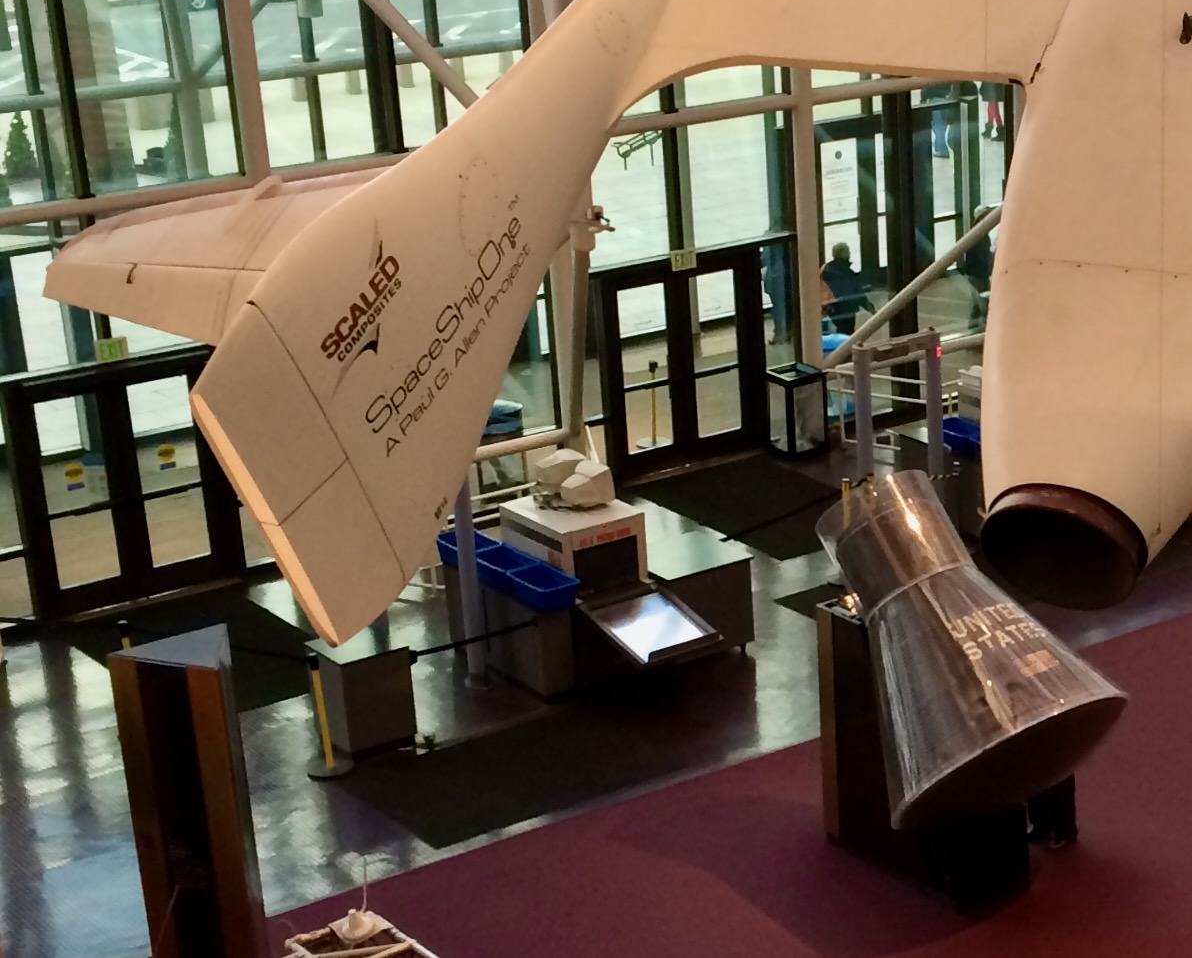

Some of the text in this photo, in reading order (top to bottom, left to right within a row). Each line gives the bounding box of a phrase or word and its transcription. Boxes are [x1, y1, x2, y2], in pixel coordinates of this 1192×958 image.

[320, 255, 400, 360] SCALED
[336, 277, 403, 362] COMPOSITES
[364, 217, 522, 434] SpaceShipOne
[385, 242, 531, 458] A Paul G. Allen Project
